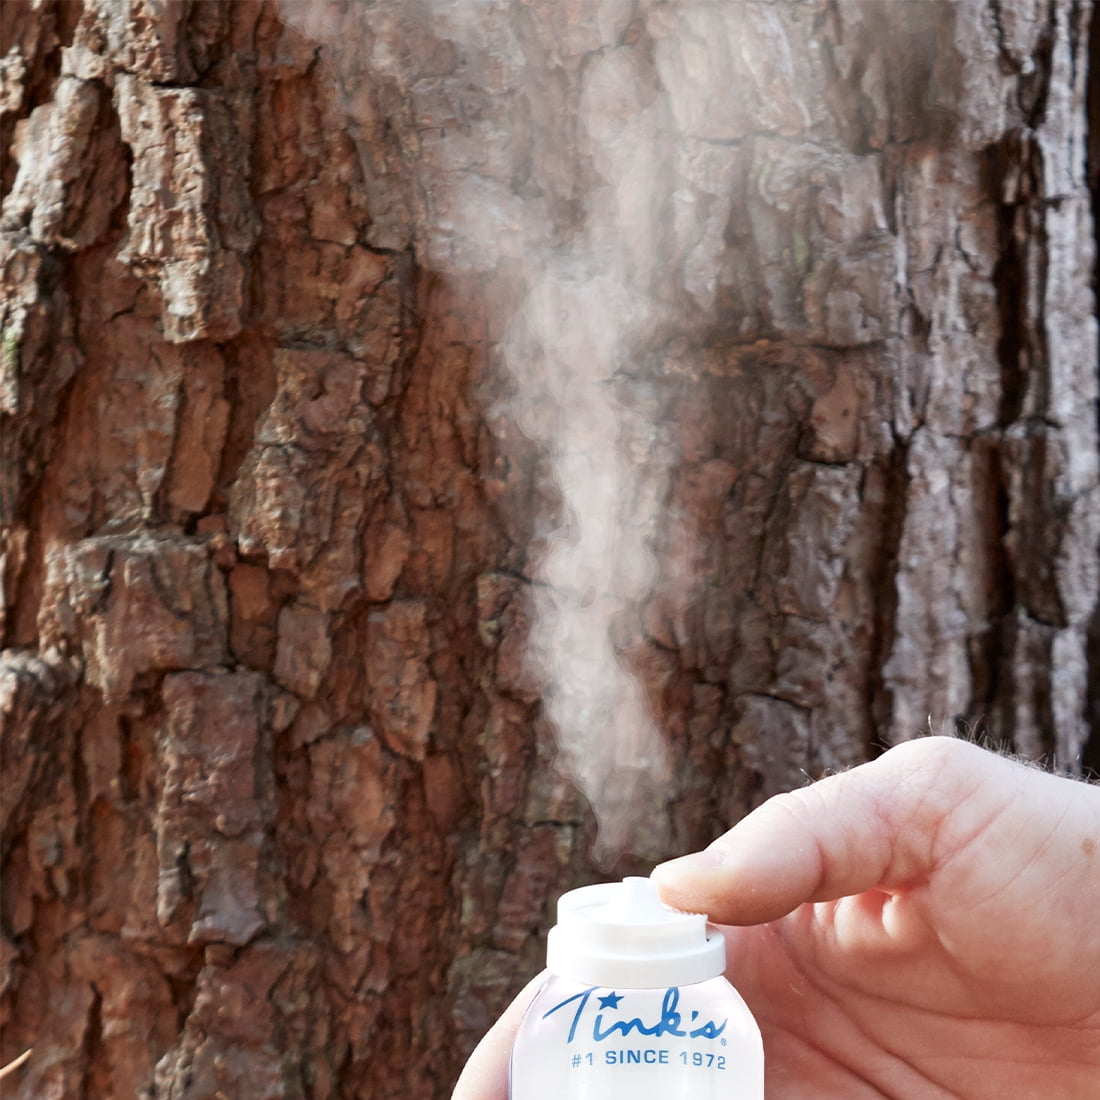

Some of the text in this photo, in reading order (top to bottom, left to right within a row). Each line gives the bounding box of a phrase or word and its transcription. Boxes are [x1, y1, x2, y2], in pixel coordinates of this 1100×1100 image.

[571, 1049, 726, 1070] #1 SINCE 1972
